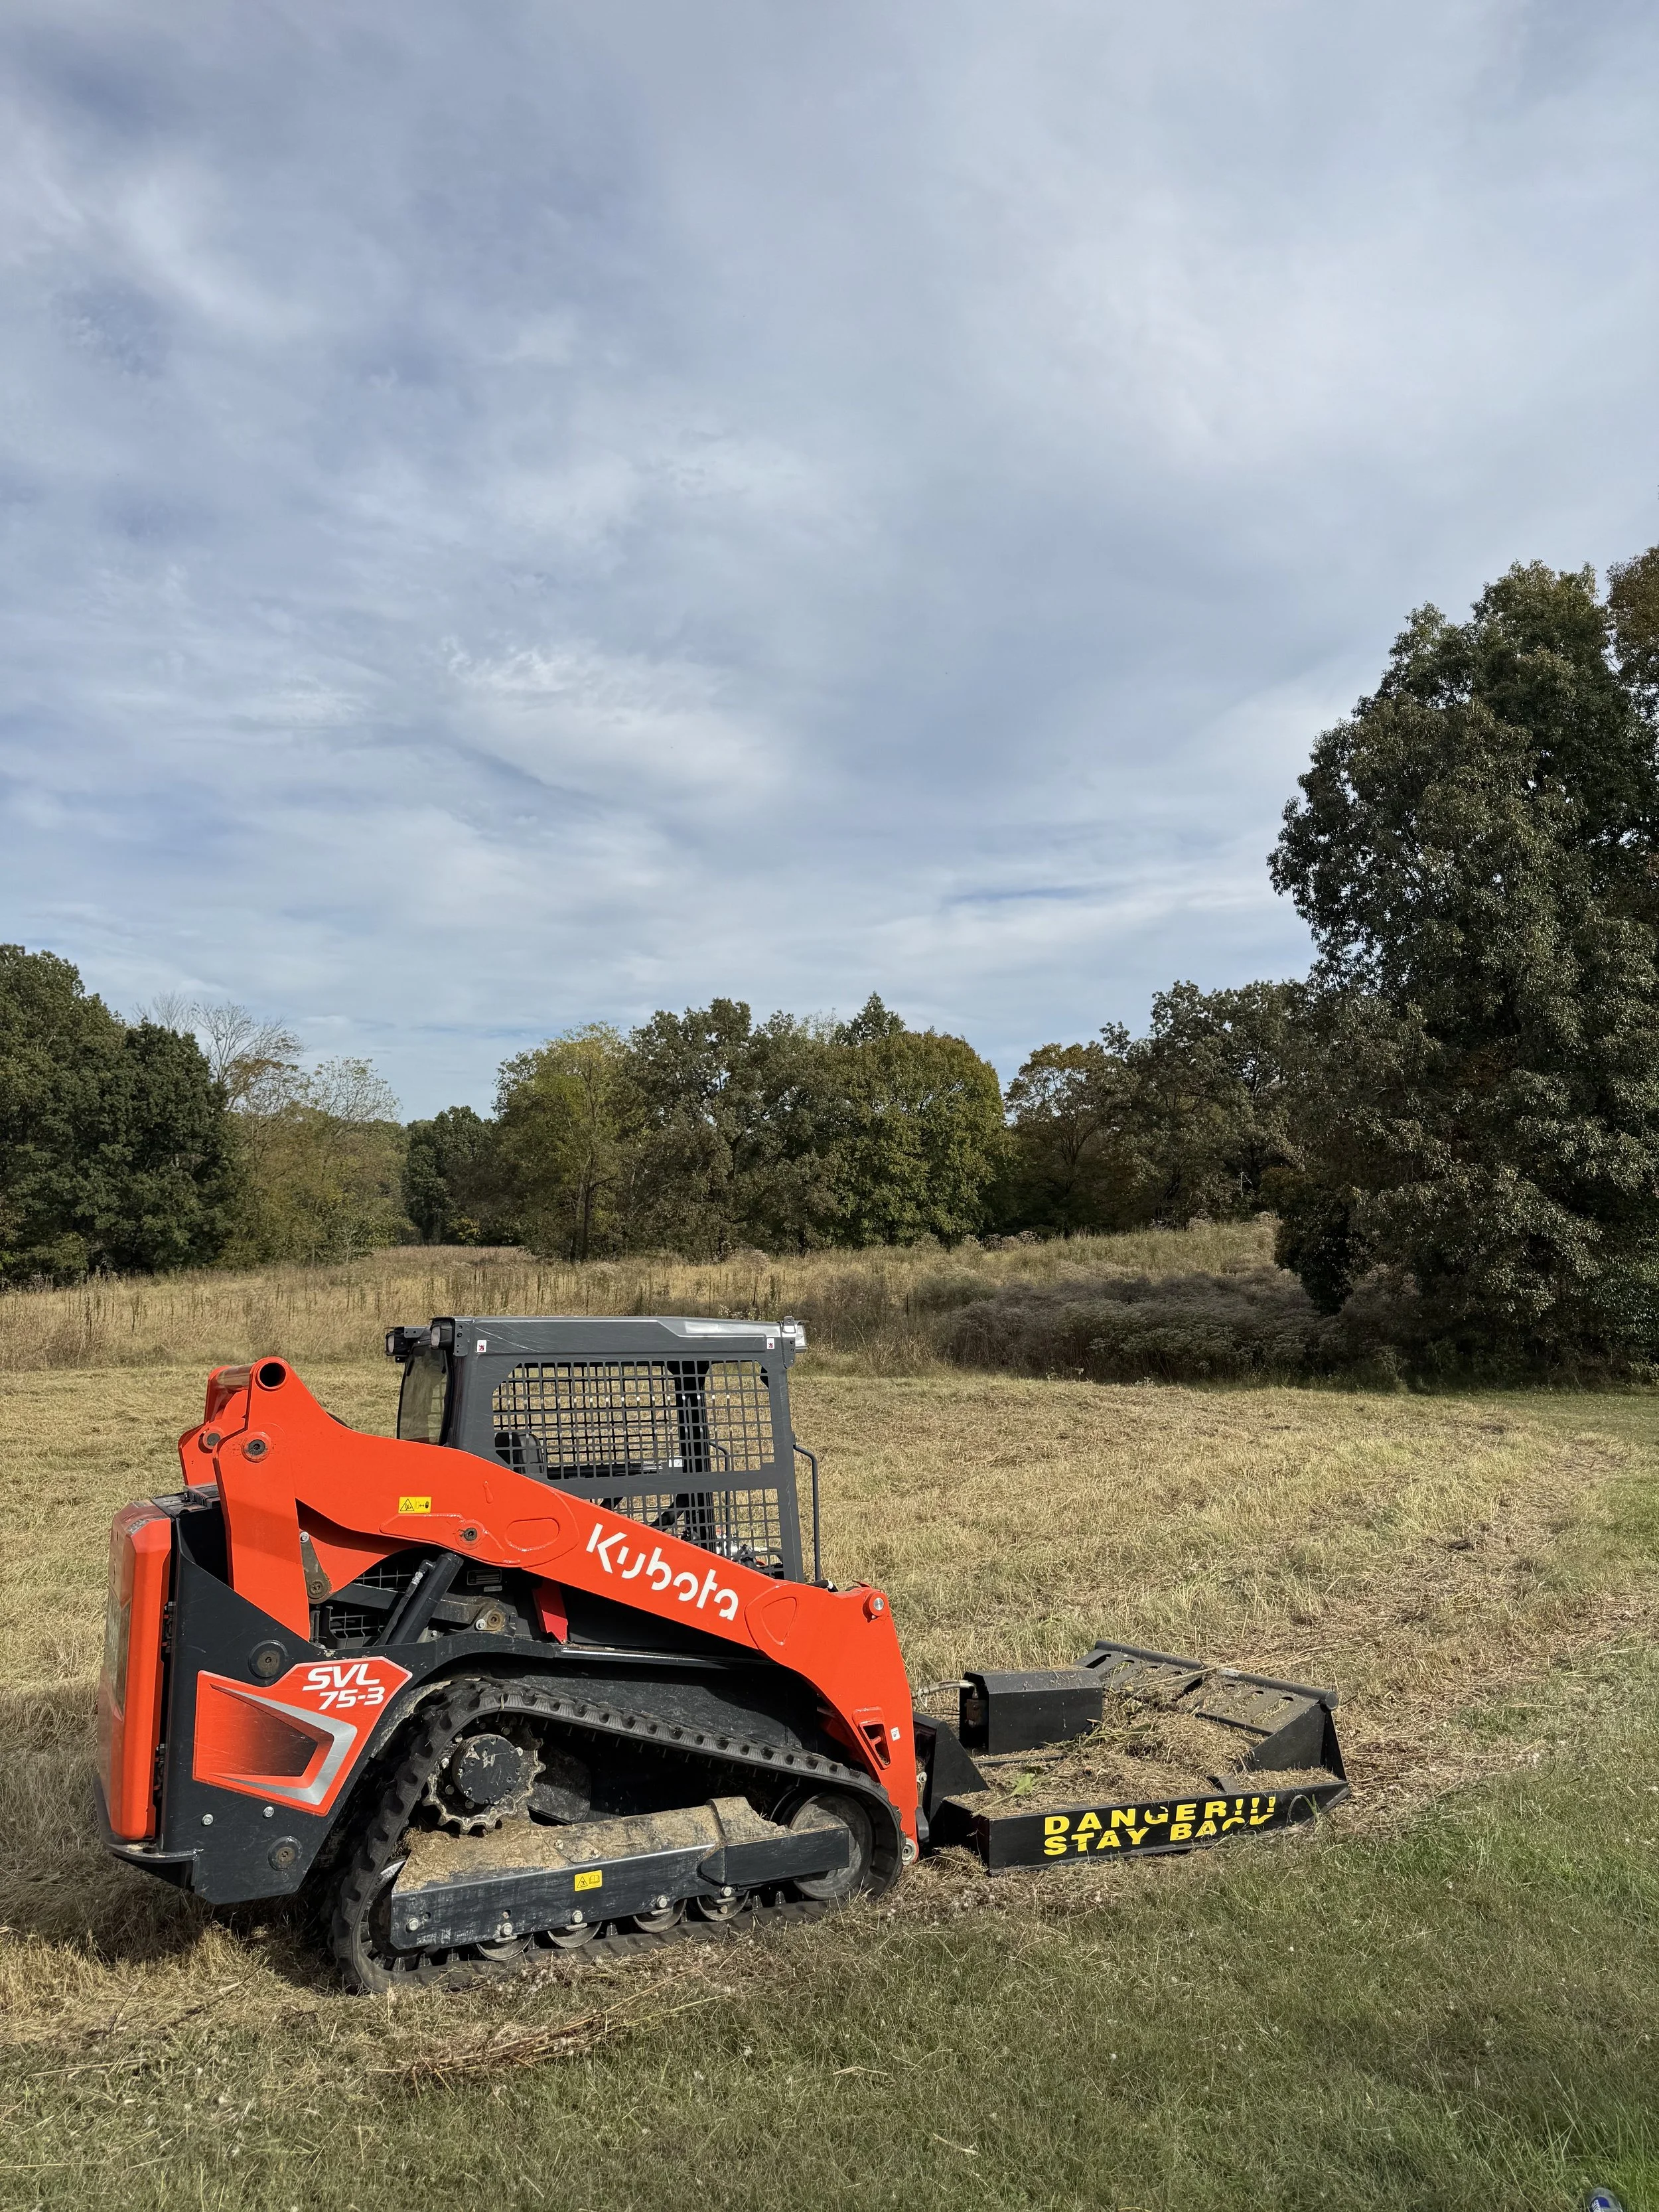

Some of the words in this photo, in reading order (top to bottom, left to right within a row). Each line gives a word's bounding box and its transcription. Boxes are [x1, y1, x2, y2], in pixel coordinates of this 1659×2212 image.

[585, 1522, 739, 1621] Kubota
[302, 1663, 380, 1691] SVL
[319, 1686, 385, 1710] 75-3
[1043, 1827, 1150, 1856] STAY
